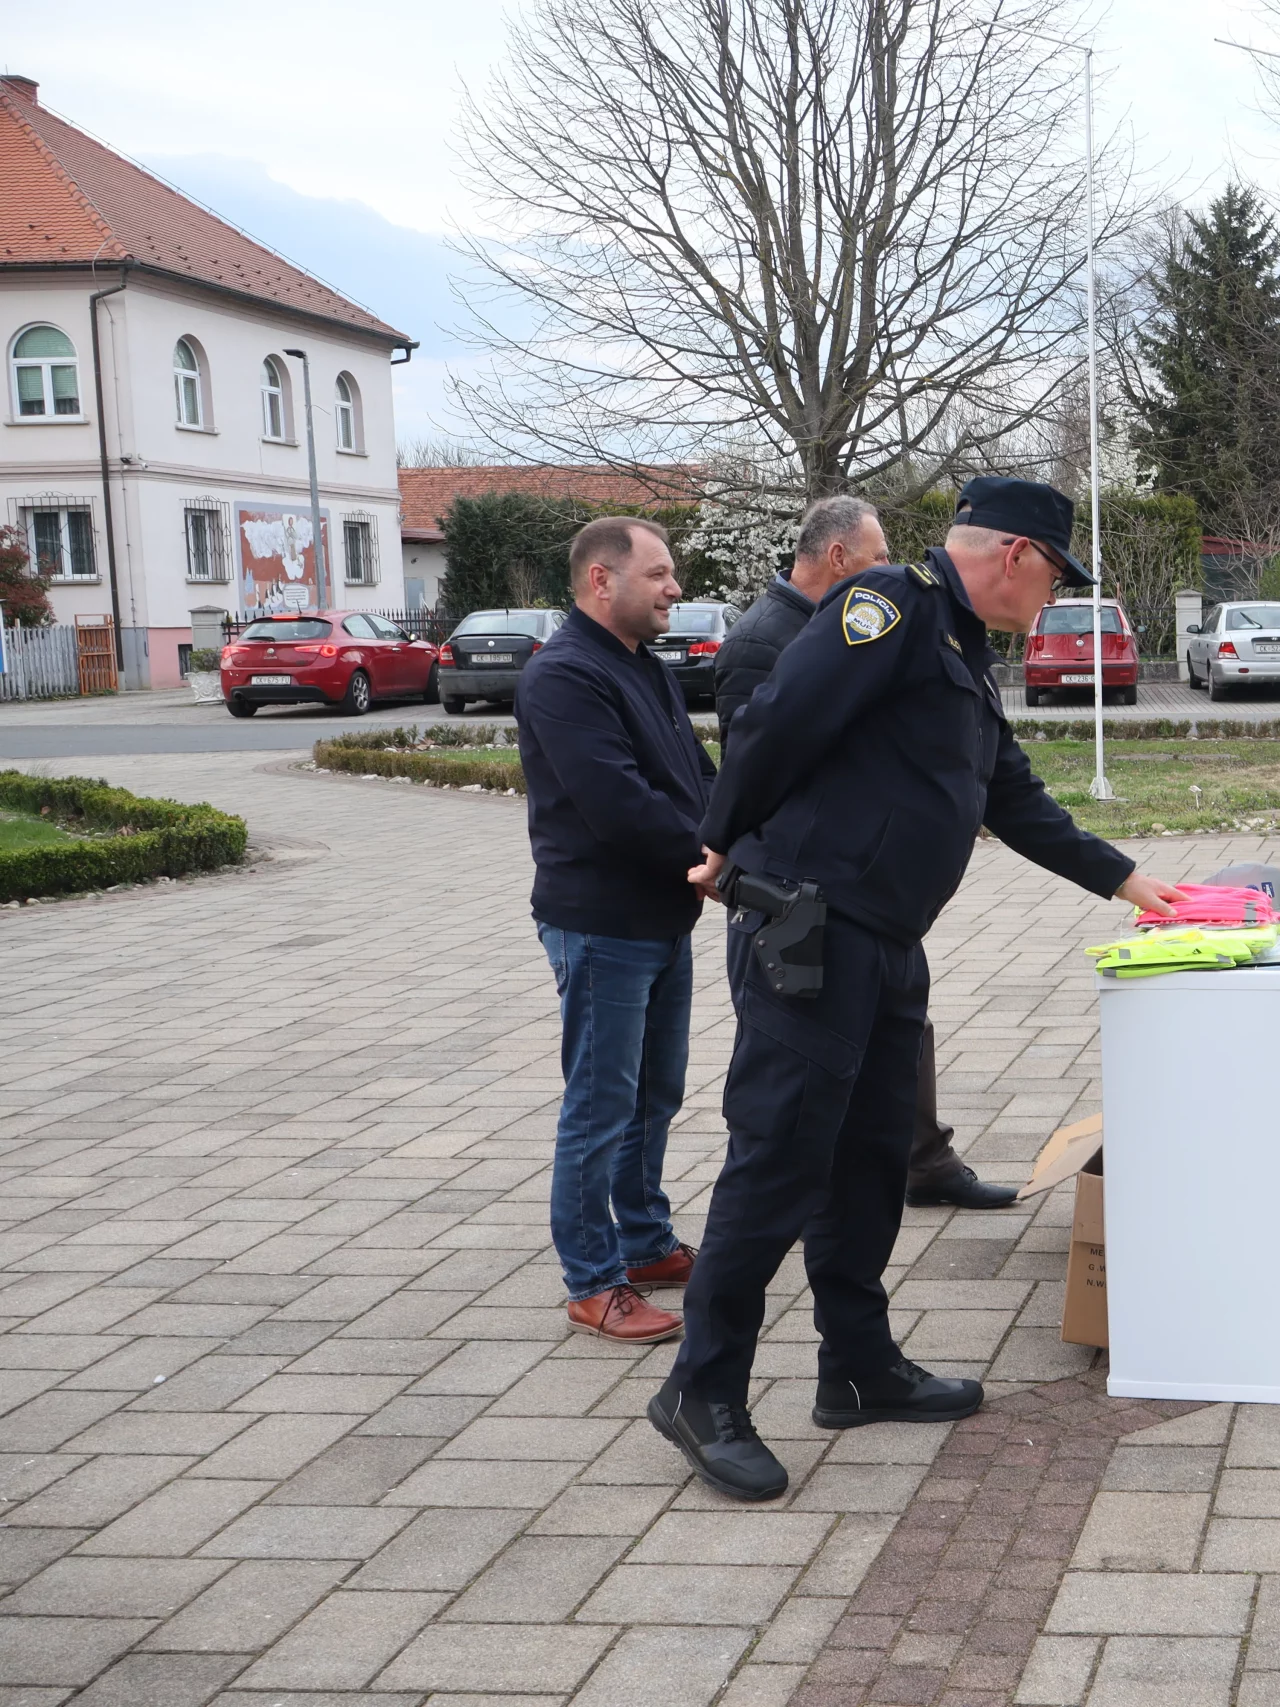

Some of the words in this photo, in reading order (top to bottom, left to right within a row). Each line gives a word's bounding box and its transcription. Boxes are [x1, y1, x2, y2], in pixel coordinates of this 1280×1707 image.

[854, 592, 896, 621] POLICIJA
[853, 617, 873, 630] MUP
[476, 654, 485, 662] CK
